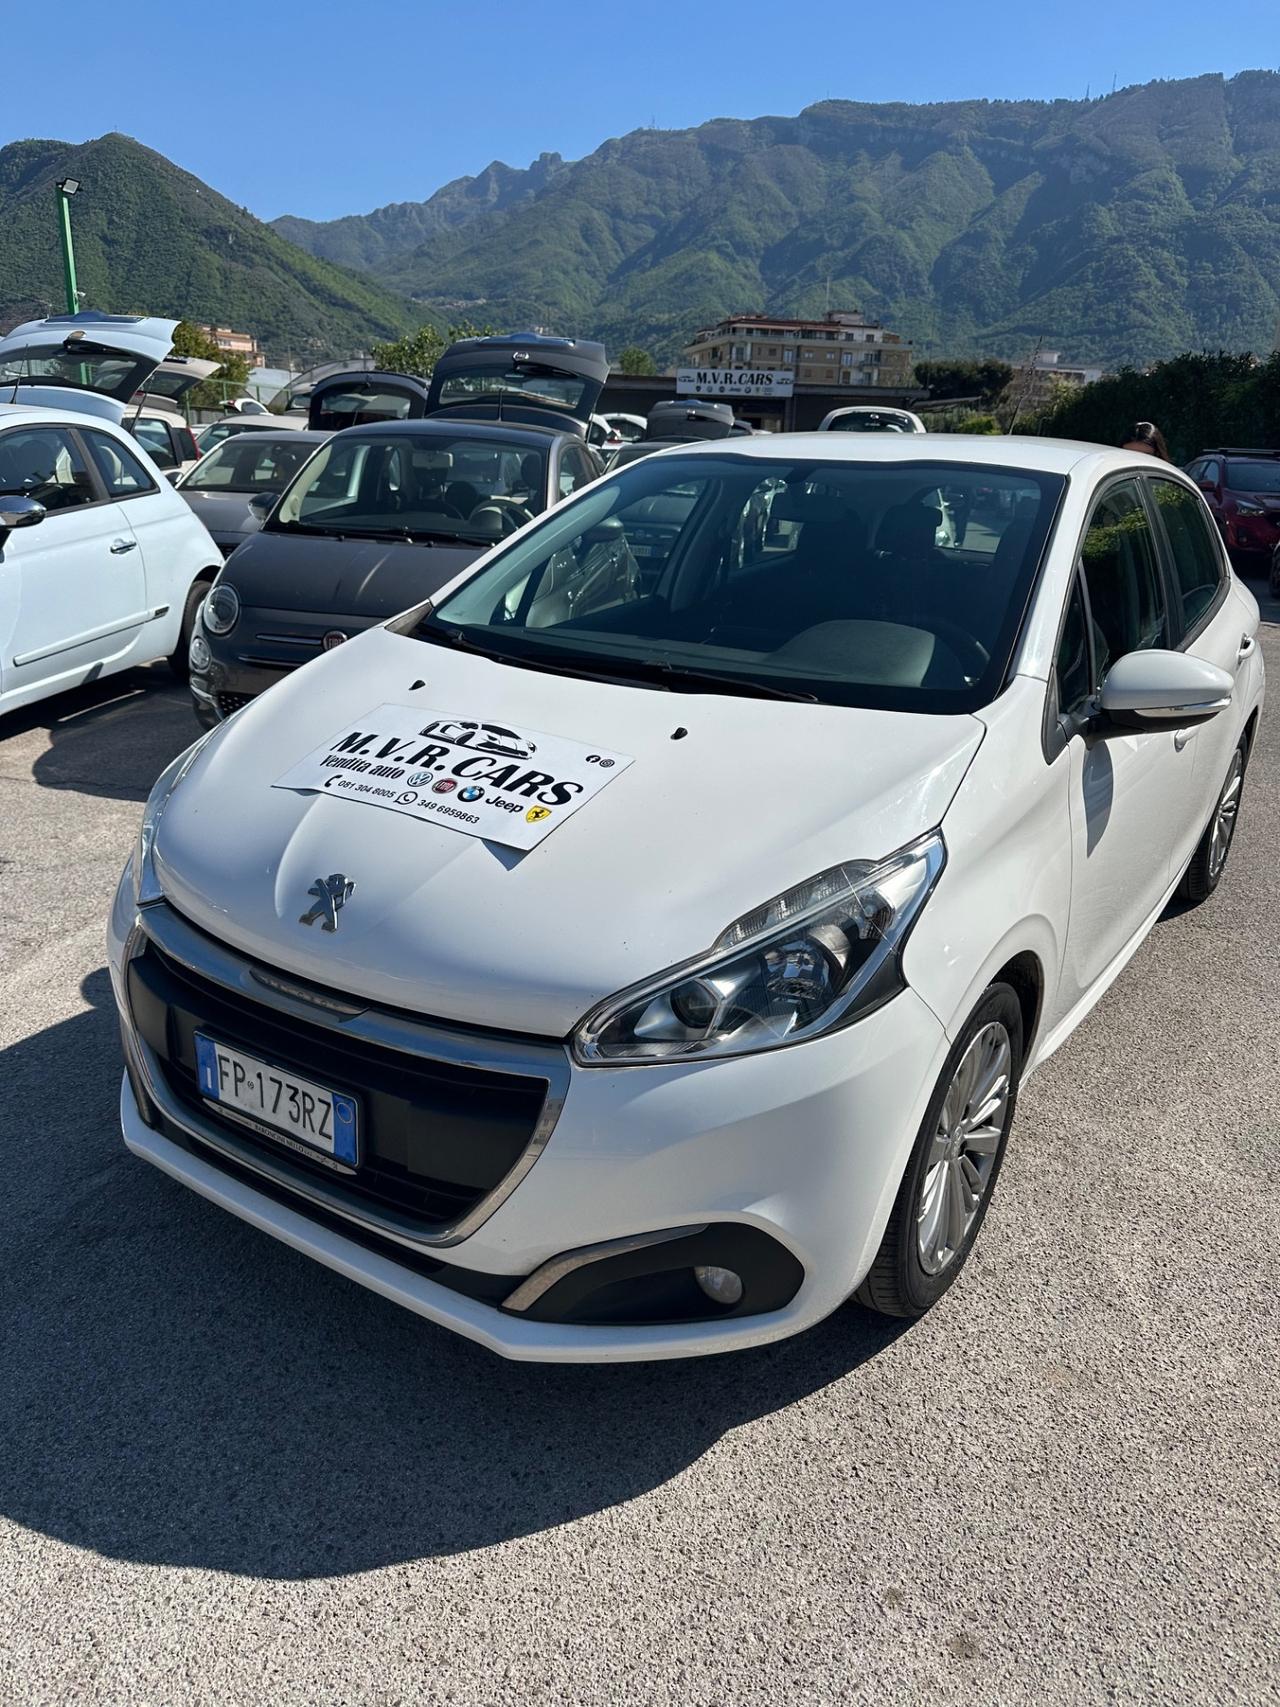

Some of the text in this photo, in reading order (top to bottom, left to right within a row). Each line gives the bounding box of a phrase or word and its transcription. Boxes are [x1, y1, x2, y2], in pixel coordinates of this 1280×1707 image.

[319, 753, 406, 780] Vendita auto
[337, 779, 398, 798] 081 304 8005
[417, 799, 481, 824] 349 6959863
[485, 795, 525, 814] Jeep
